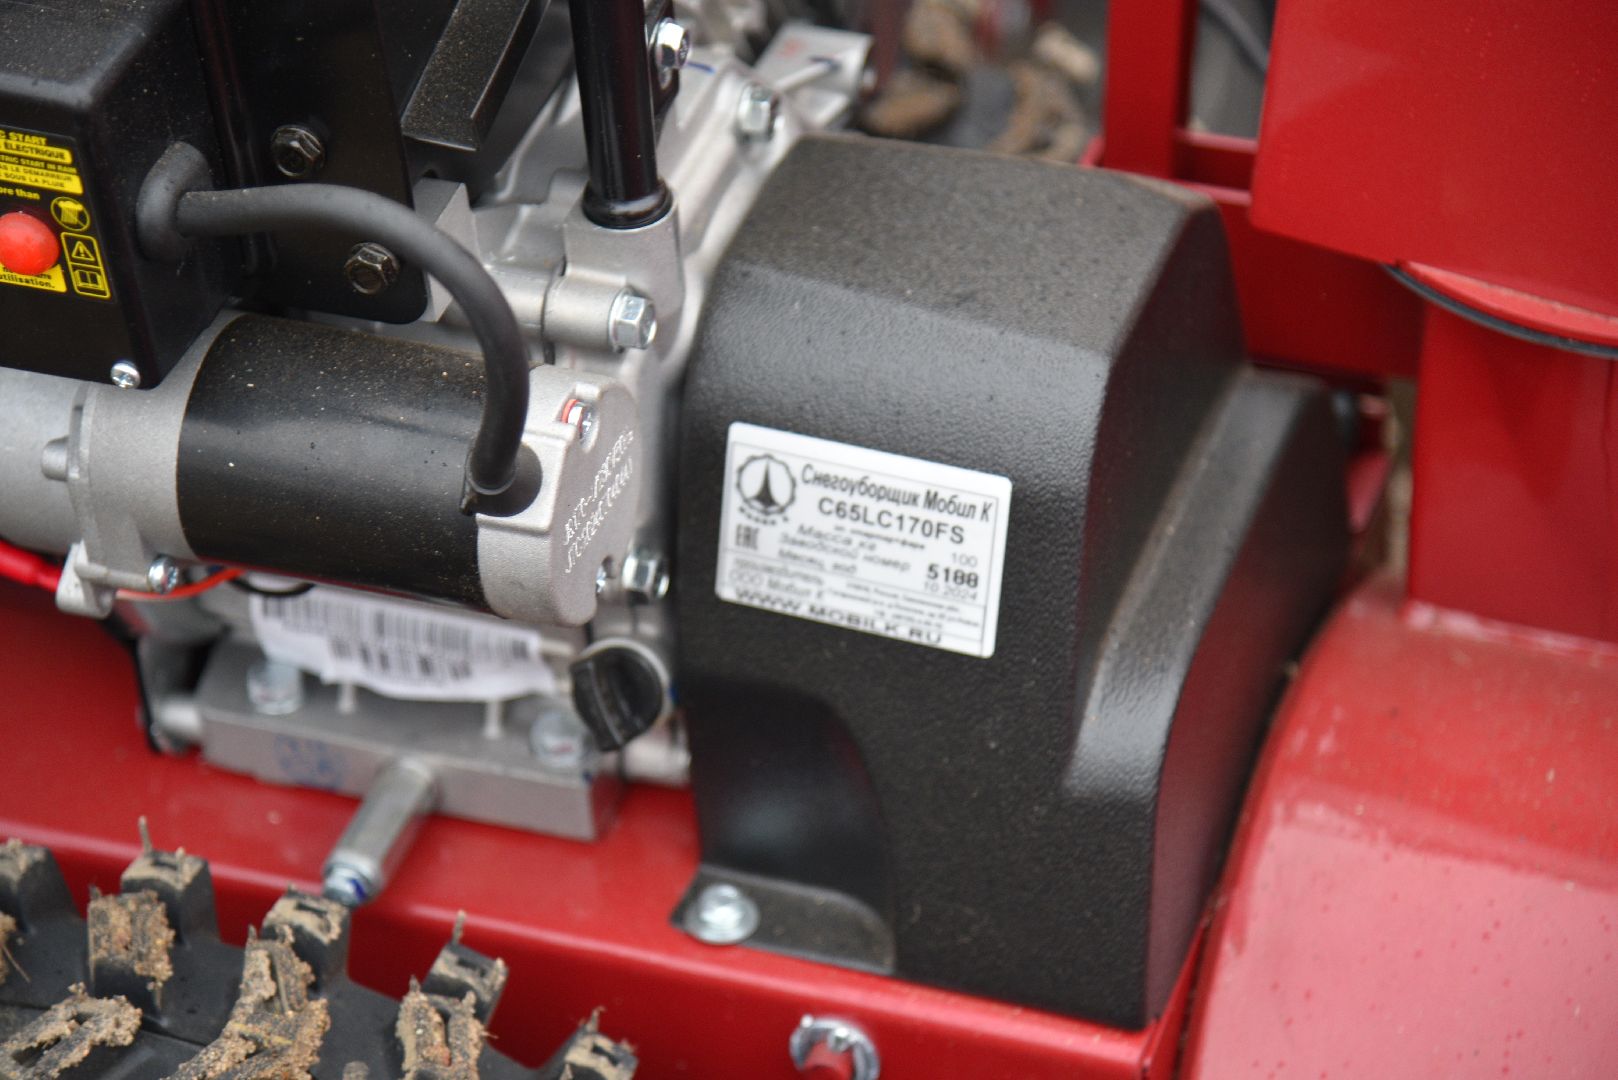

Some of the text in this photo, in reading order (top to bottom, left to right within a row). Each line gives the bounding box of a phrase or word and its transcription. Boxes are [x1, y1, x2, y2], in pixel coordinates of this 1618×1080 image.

[9, 132, 47, 146] START
[20, 158, 45, 169] START
[15, 188, 40, 200] than
[801, 463, 920, 507] Снегоуборщик
[923, 490, 977, 519] Мобил
[817, 496, 965, 545] C65LC170FS
[797, 524, 853, 546] Масса
[863, 554, 911, 573] номер
[951, 552, 978, 568] 100
[927, 563, 979, 589] 5188
